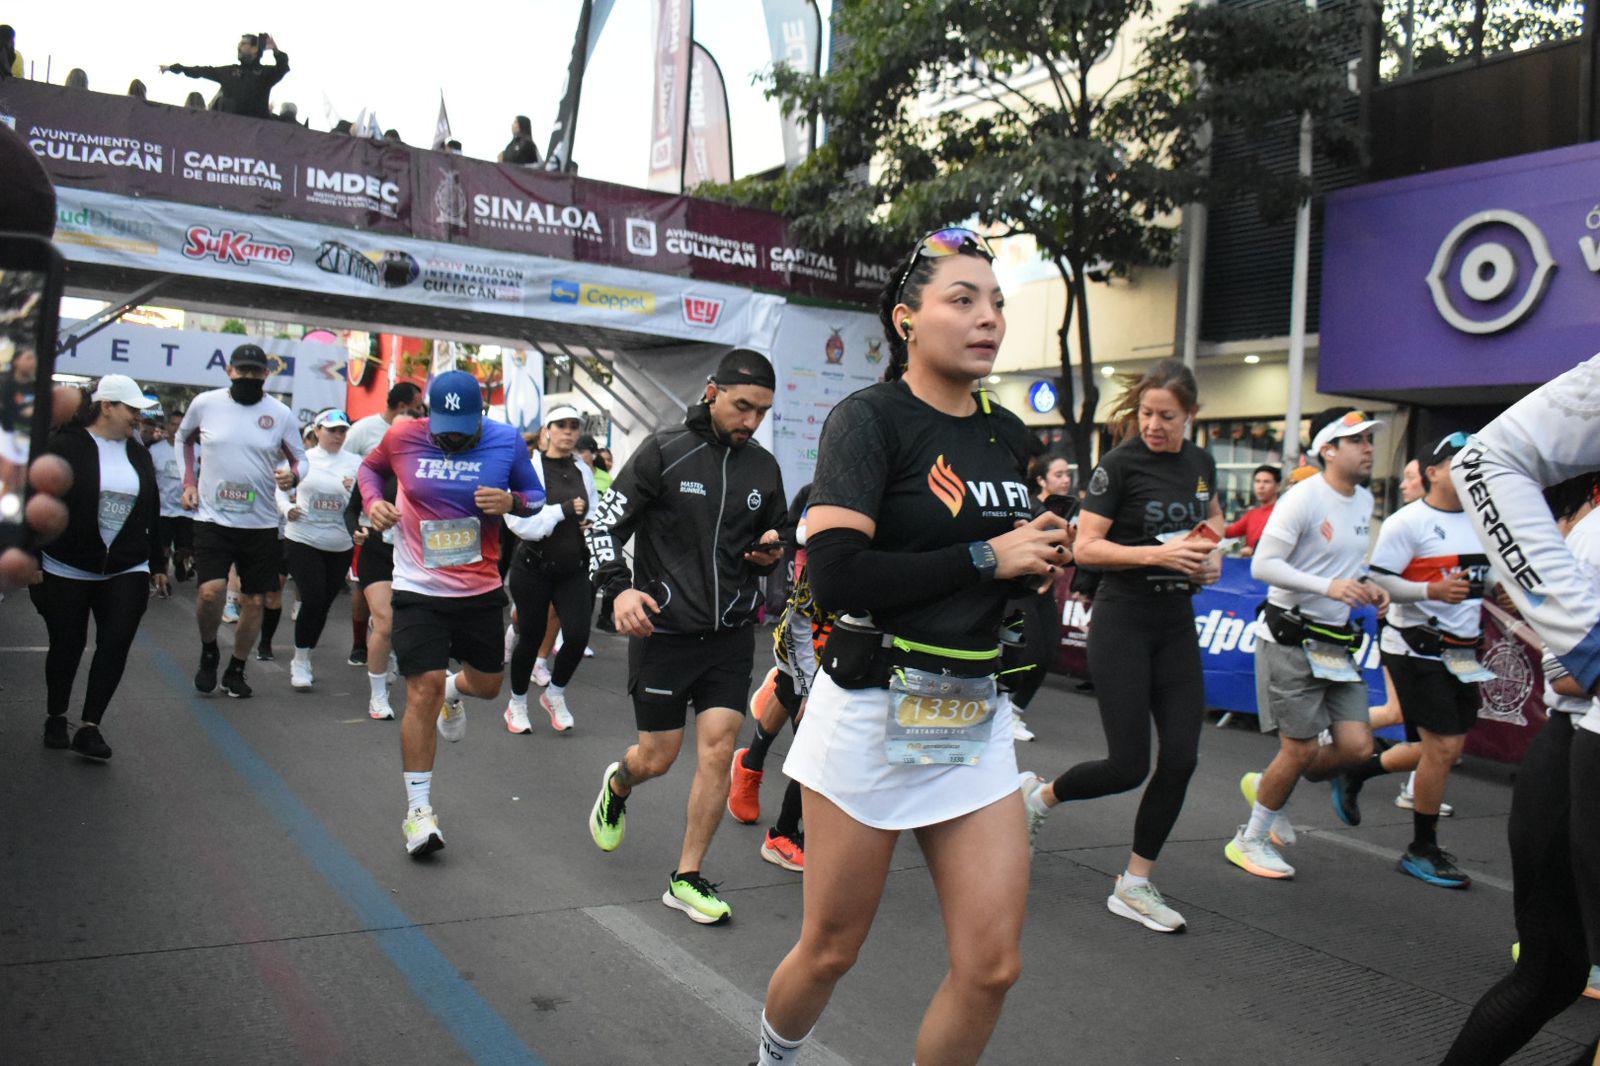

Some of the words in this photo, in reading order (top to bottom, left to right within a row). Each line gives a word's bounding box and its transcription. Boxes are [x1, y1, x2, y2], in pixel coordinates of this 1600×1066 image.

[30, 126, 140, 150] AYUNTAMIENTO
[144, 142, 162, 155] DE
[184, 151, 282, 180] CAPITAL
[183, 168, 202, 181] DE
[206, 172, 282, 192] BIENESTAR
[306, 166, 400, 204] IMDEC
[473, 193, 602, 235] SINALOA
[184, 226, 292, 263] SuKarne
[666, 228, 741, 250] AYUNTAMIENTO
[742, 243, 755, 253] DE
[770, 247, 837, 270] CAPITAL
[770, 262, 785, 272] DE
[425, 270, 520, 288] INTERNACIONAL
[586, 289, 645, 309] Coppel
[445, 392, 460, 411] NY
[416, 458, 482, 472] TRACK
[223, 489, 247, 500] 1894
[679, 481, 704, 489] MASTER
[679, 486, 706, 496] RUNNERS
[966, 481, 1000, 507] VI
[316, 500, 340, 510] 1825
[434, 531, 471, 546] 1323
[913, 697, 980, 721] 1330
